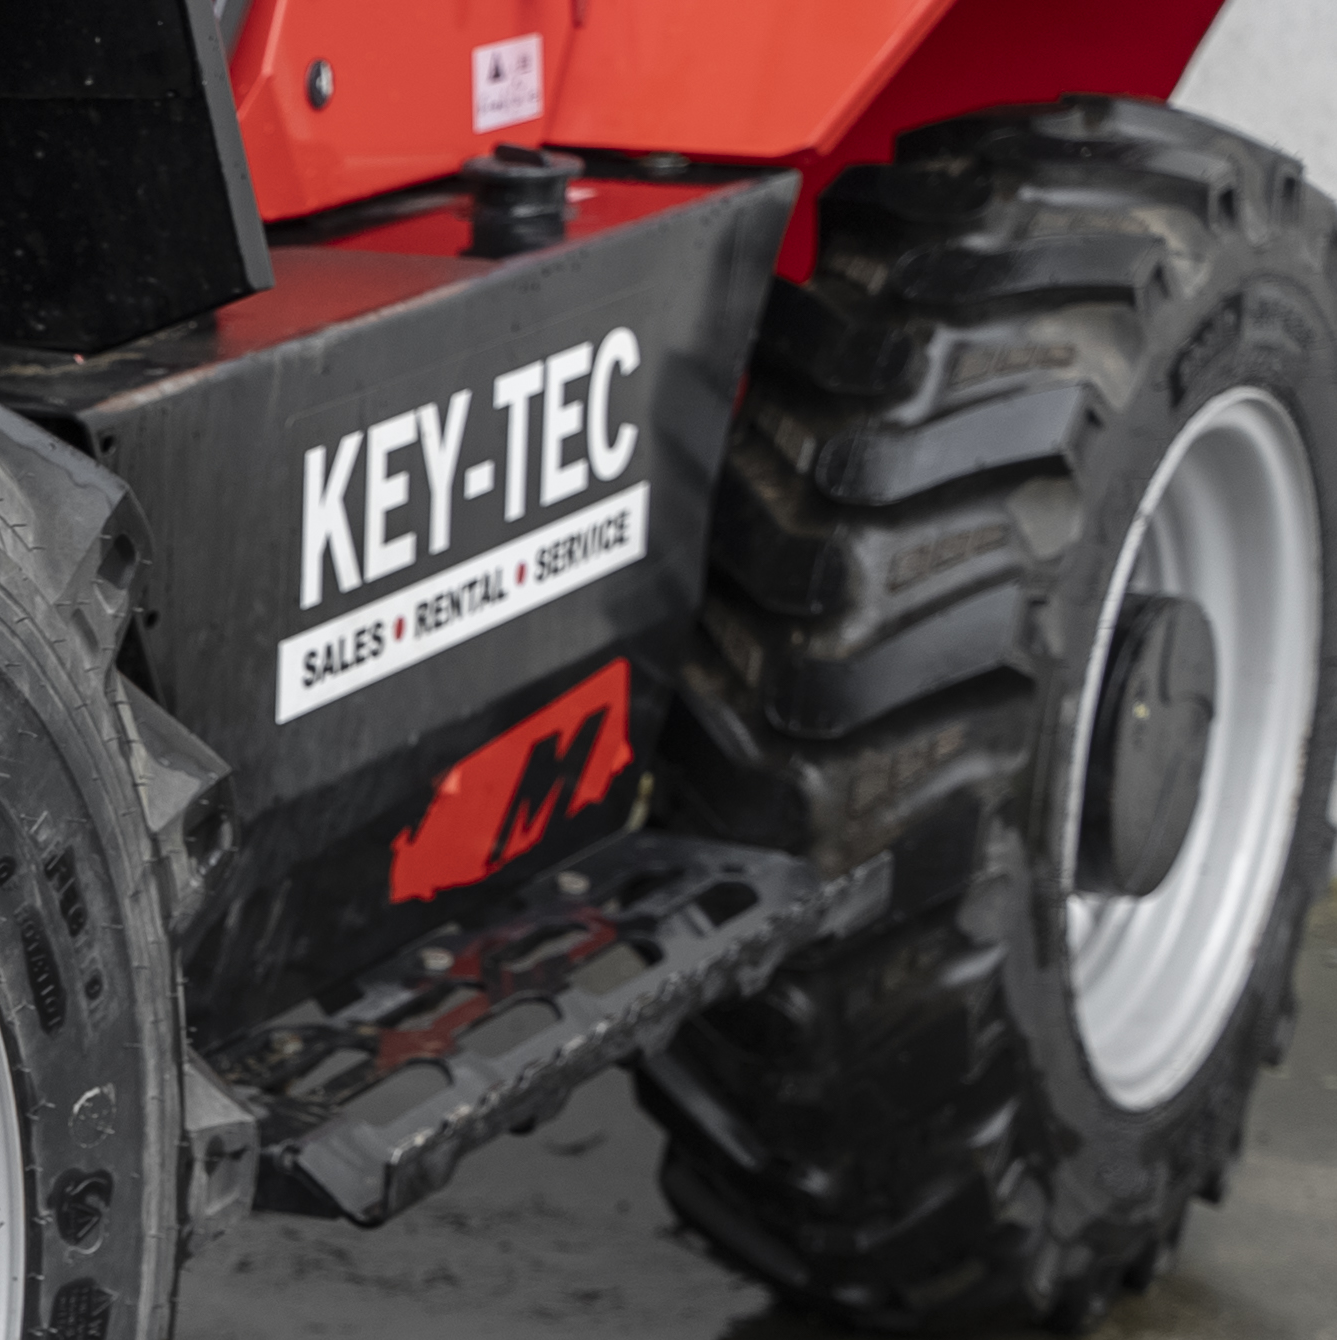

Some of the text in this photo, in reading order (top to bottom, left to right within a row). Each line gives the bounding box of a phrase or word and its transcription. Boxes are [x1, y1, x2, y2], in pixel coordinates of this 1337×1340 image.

[300, 327, 642, 610] KEY-TEC
[301, 510, 630, 690] SALES RENTAL SERVICE
